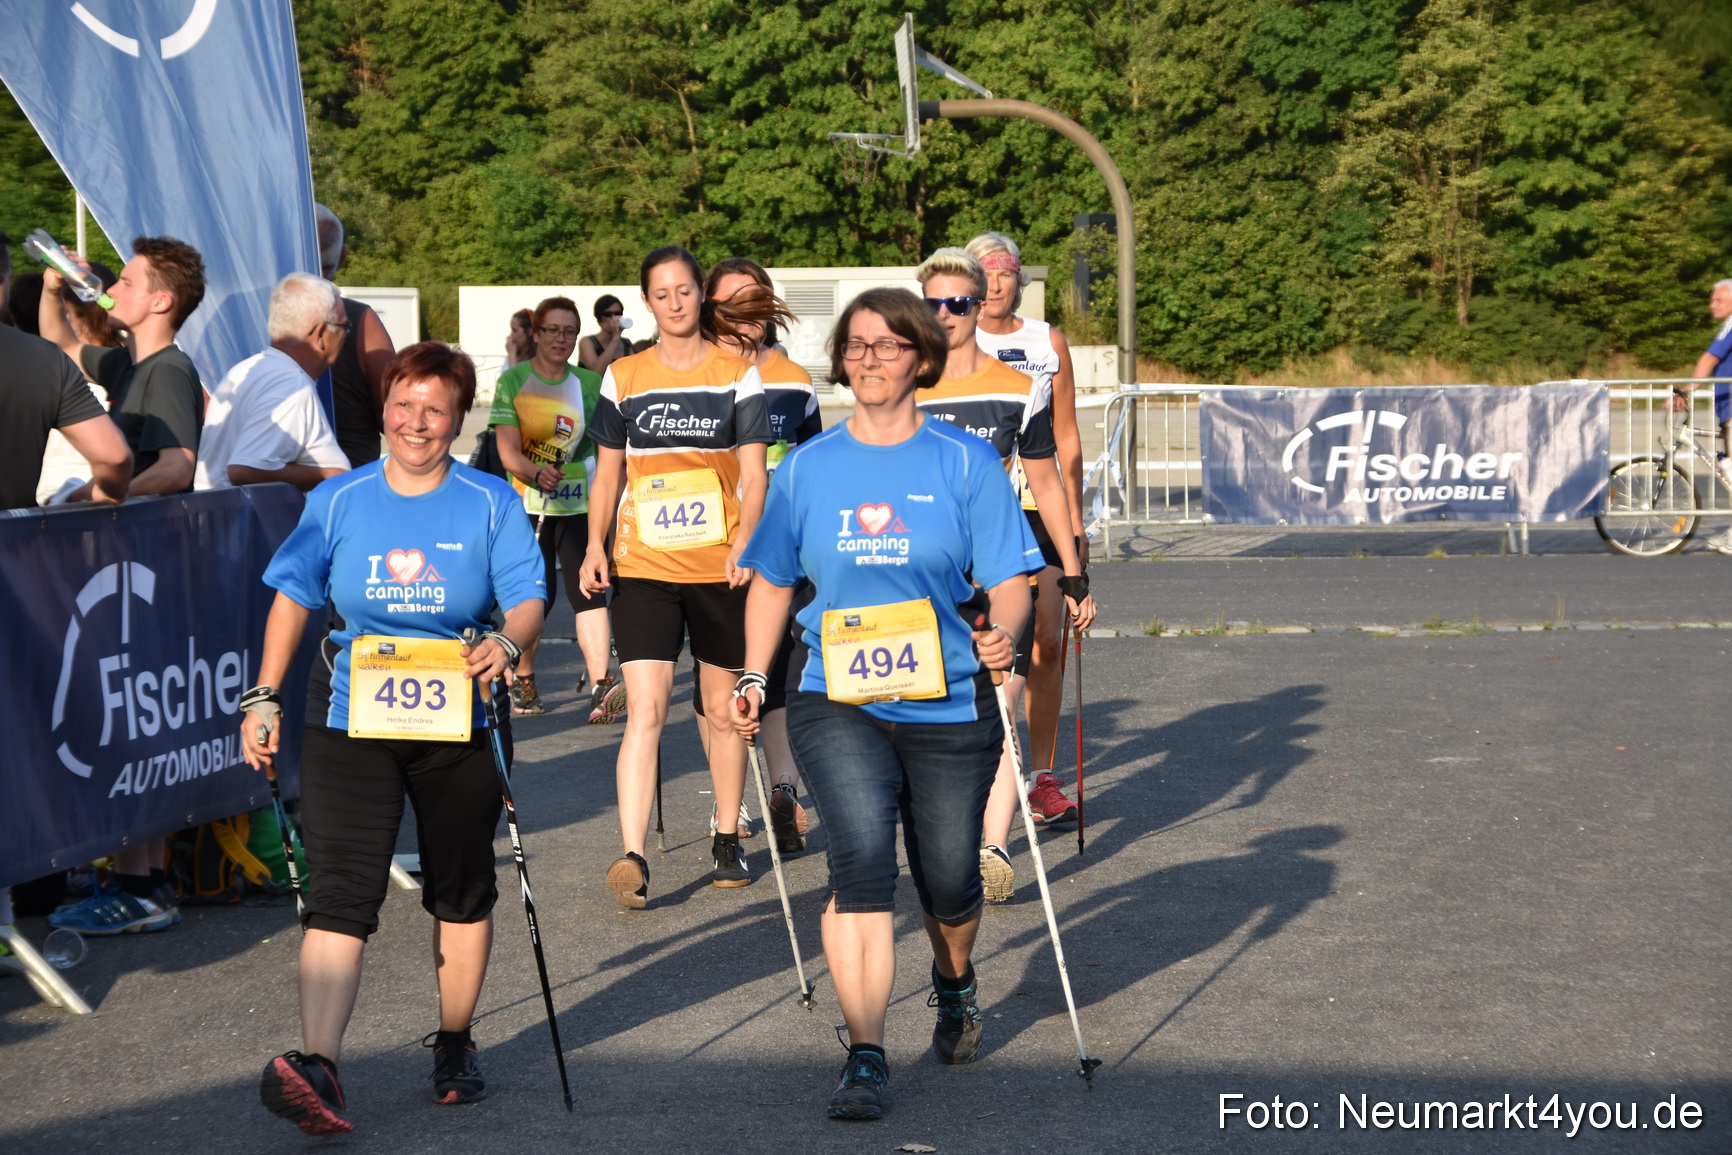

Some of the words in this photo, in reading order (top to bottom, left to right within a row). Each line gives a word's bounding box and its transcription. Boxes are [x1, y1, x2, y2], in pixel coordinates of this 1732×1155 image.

[649, 415, 720, 429] Fischer
[1326, 443, 1523, 482] Fischer
[1343, 485, 1507, 503] AUTOMOBILE
[653, 501, 707, 529] 442
[837, 509, 854, 537] I
[837, 534, 909, 554] camping
[365, 555, 382, 584] I
[882, 555, 909, 566] Berger
[365, 583, 445, 604] camping
[416, 603, 445, 614] Berger
[370, 653, 411, 662] firmenlauf
[848, 642, 919, 680] 494
[374, 677, 447, 711] 493
[857, 685, 883, 694] Martina
[884, 681, 915, 691] Queisser
[387, 716, 407, 724] Heike
[408, 716, 433, 724] Endres
